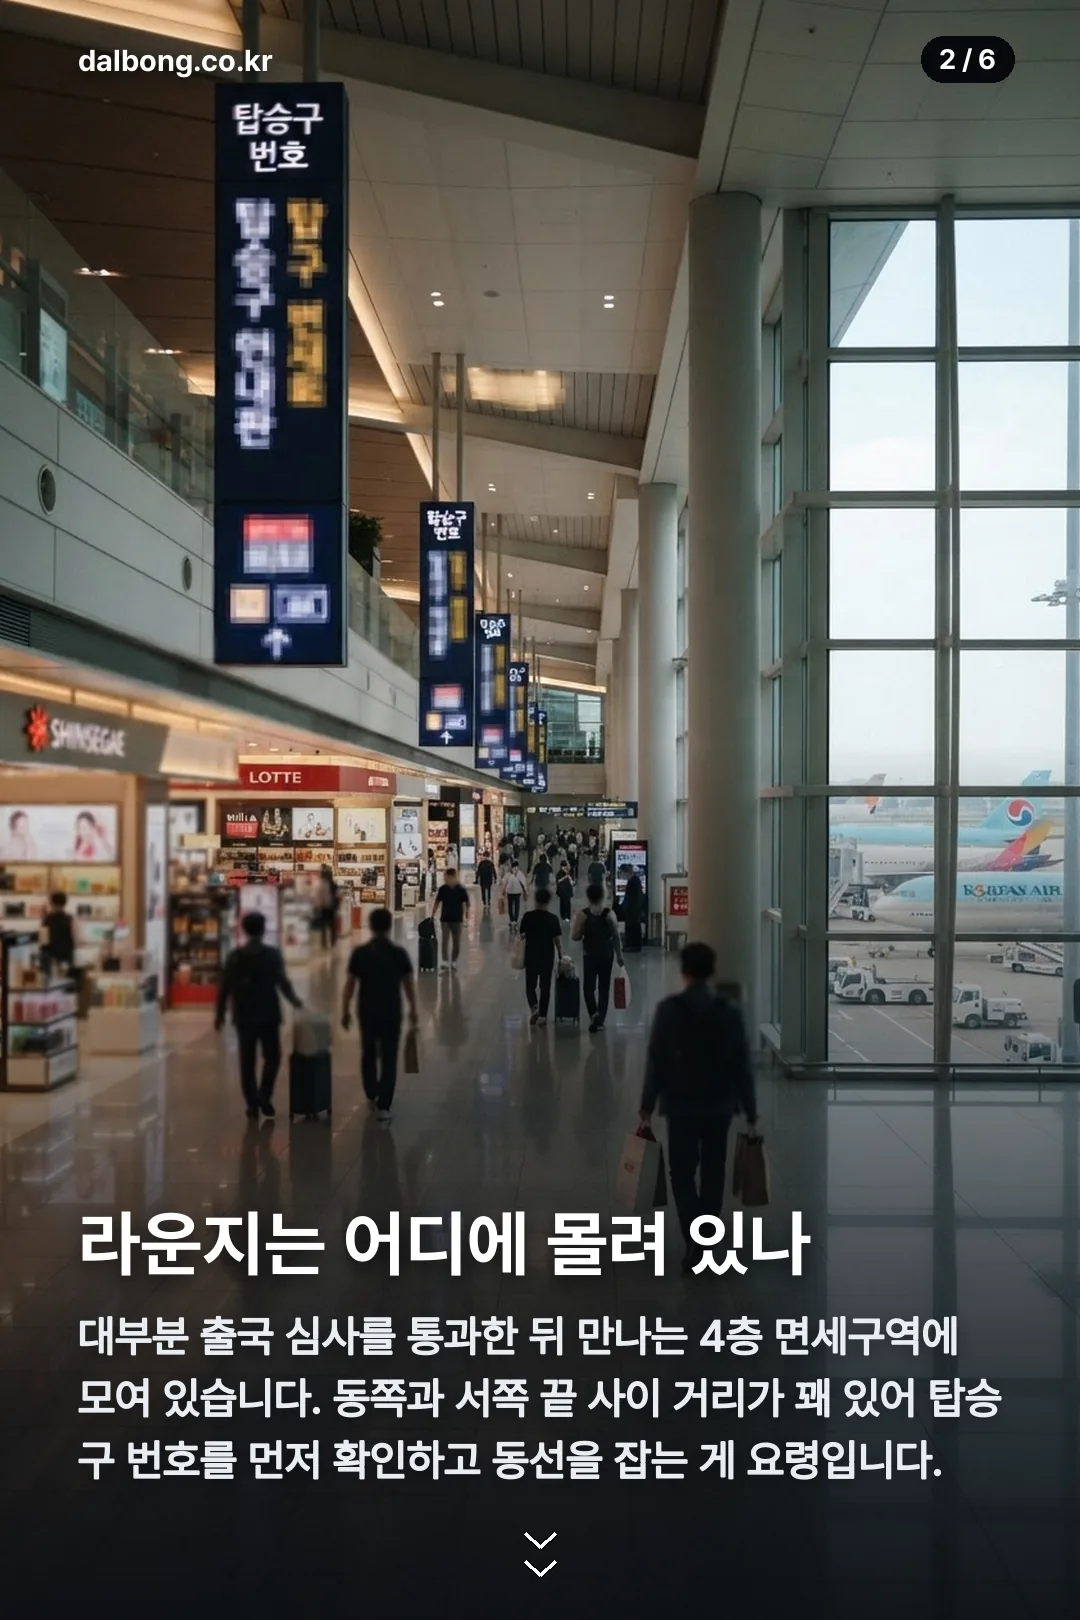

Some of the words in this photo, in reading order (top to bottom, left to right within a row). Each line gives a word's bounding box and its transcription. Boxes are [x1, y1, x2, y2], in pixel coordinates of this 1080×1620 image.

[233, 102, 324, 136] 탑승구
[249, 140, 309, 173] 번호
[249, 771, 301, 784] LOTTE
[1030, 884, 1063, 896] AIR
